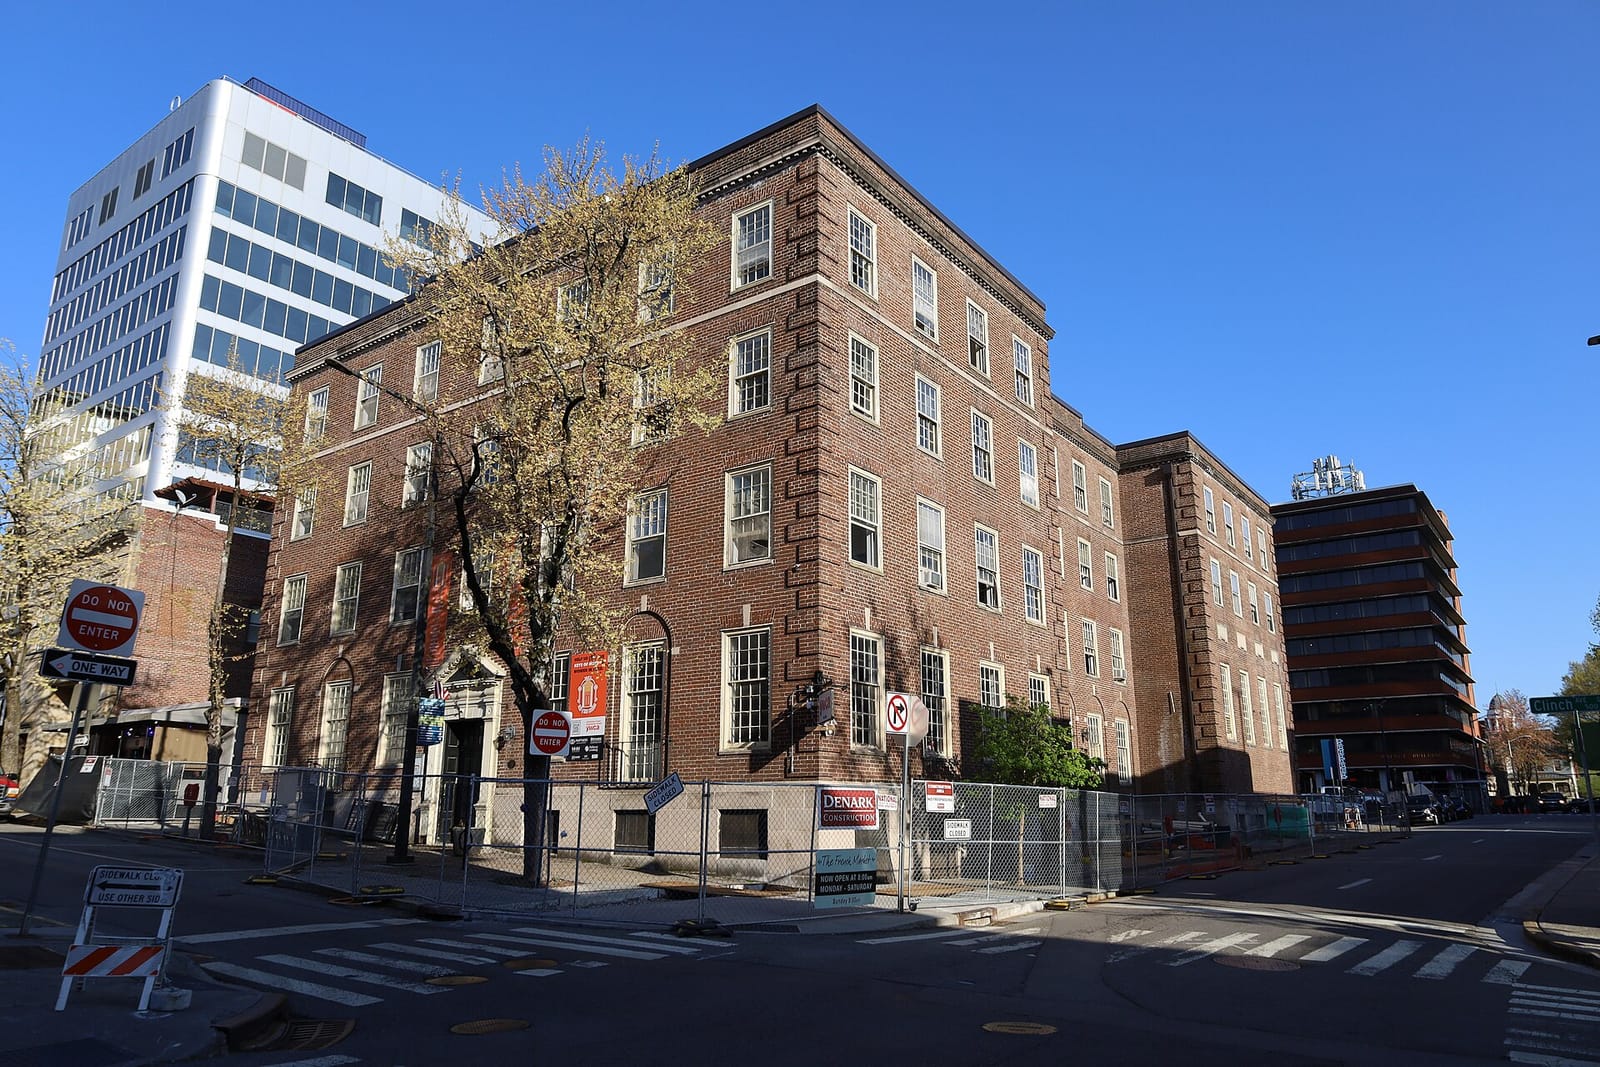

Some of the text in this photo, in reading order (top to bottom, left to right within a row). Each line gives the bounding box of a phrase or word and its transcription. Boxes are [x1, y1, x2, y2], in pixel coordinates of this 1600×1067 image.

[81, 594, 132, 612] DO NOT
[78, 624, 120, 641] ENTER
[71, 661, 127, 677] ONE WAY
[1534, 699, 1573, 711] Clinch
[552, 719, 566, 727] NOT
[539, 738, 561, 746] ENTER
[647, 776, 677, 801] SIDEWALK
[654, 786, 677, 807] CLOSED
[823, 794, 874, 808] DENARK
[823, 813, 875, 822] CONSTRUCTION
[821, 855, 834, 867] The
[99, 870, 142, 880] SIDEWALK
[820, 874, 834, 883] NOW
[834, 874, 850, 882] OPEN
[850, 873, 857, 881] AT
[820, 884, 843, 893] MONDAY
[847, 882, 873, 892] SATURDAY
[98, 893, 116, 902] USE
[117, 893, 145, 903] OTHER
